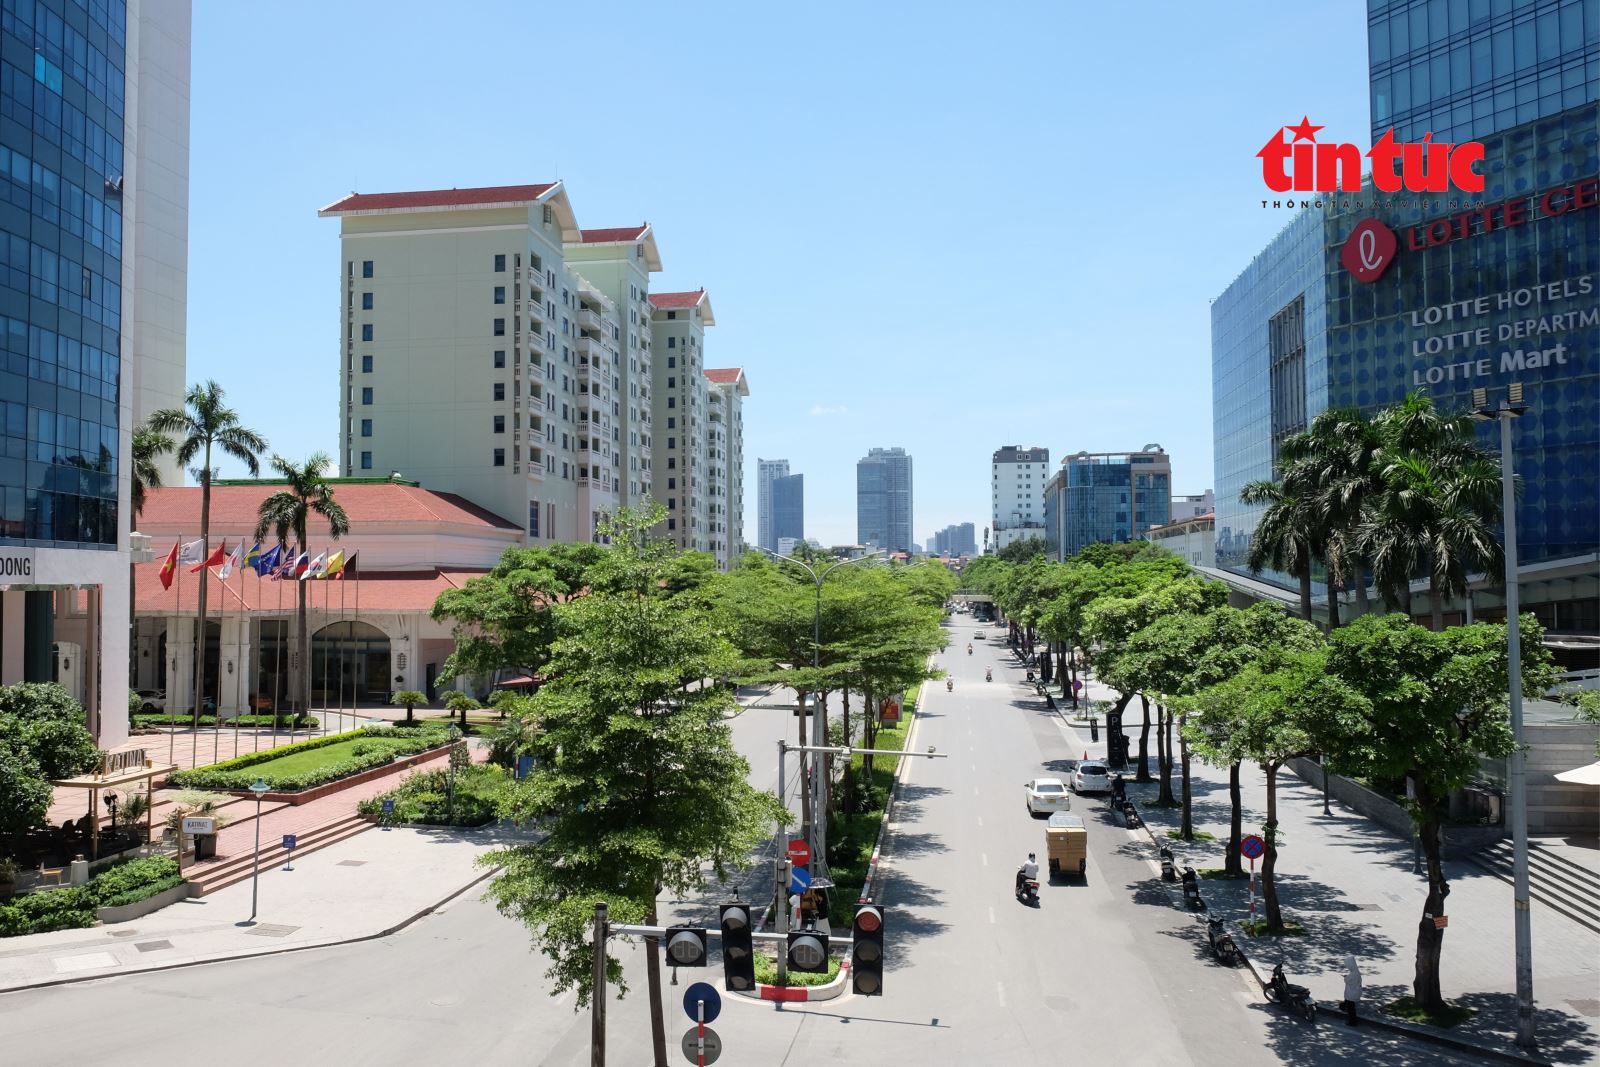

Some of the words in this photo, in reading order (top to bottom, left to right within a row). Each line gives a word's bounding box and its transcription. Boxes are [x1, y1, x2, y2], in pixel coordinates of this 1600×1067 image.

[1407, 198, 1527, 250] LOTTE
[1411, 295, 1491, 327] LOTTE
[1497, 275, 1593, 310] HOTELS
[1412, 327, 1491, 356] LOTTE
[1498, 307, 1600, 341] DEPARTM
[1413, 358, 1492, 386] LOTTE
[1500, 342, 1568, 373] Mart
